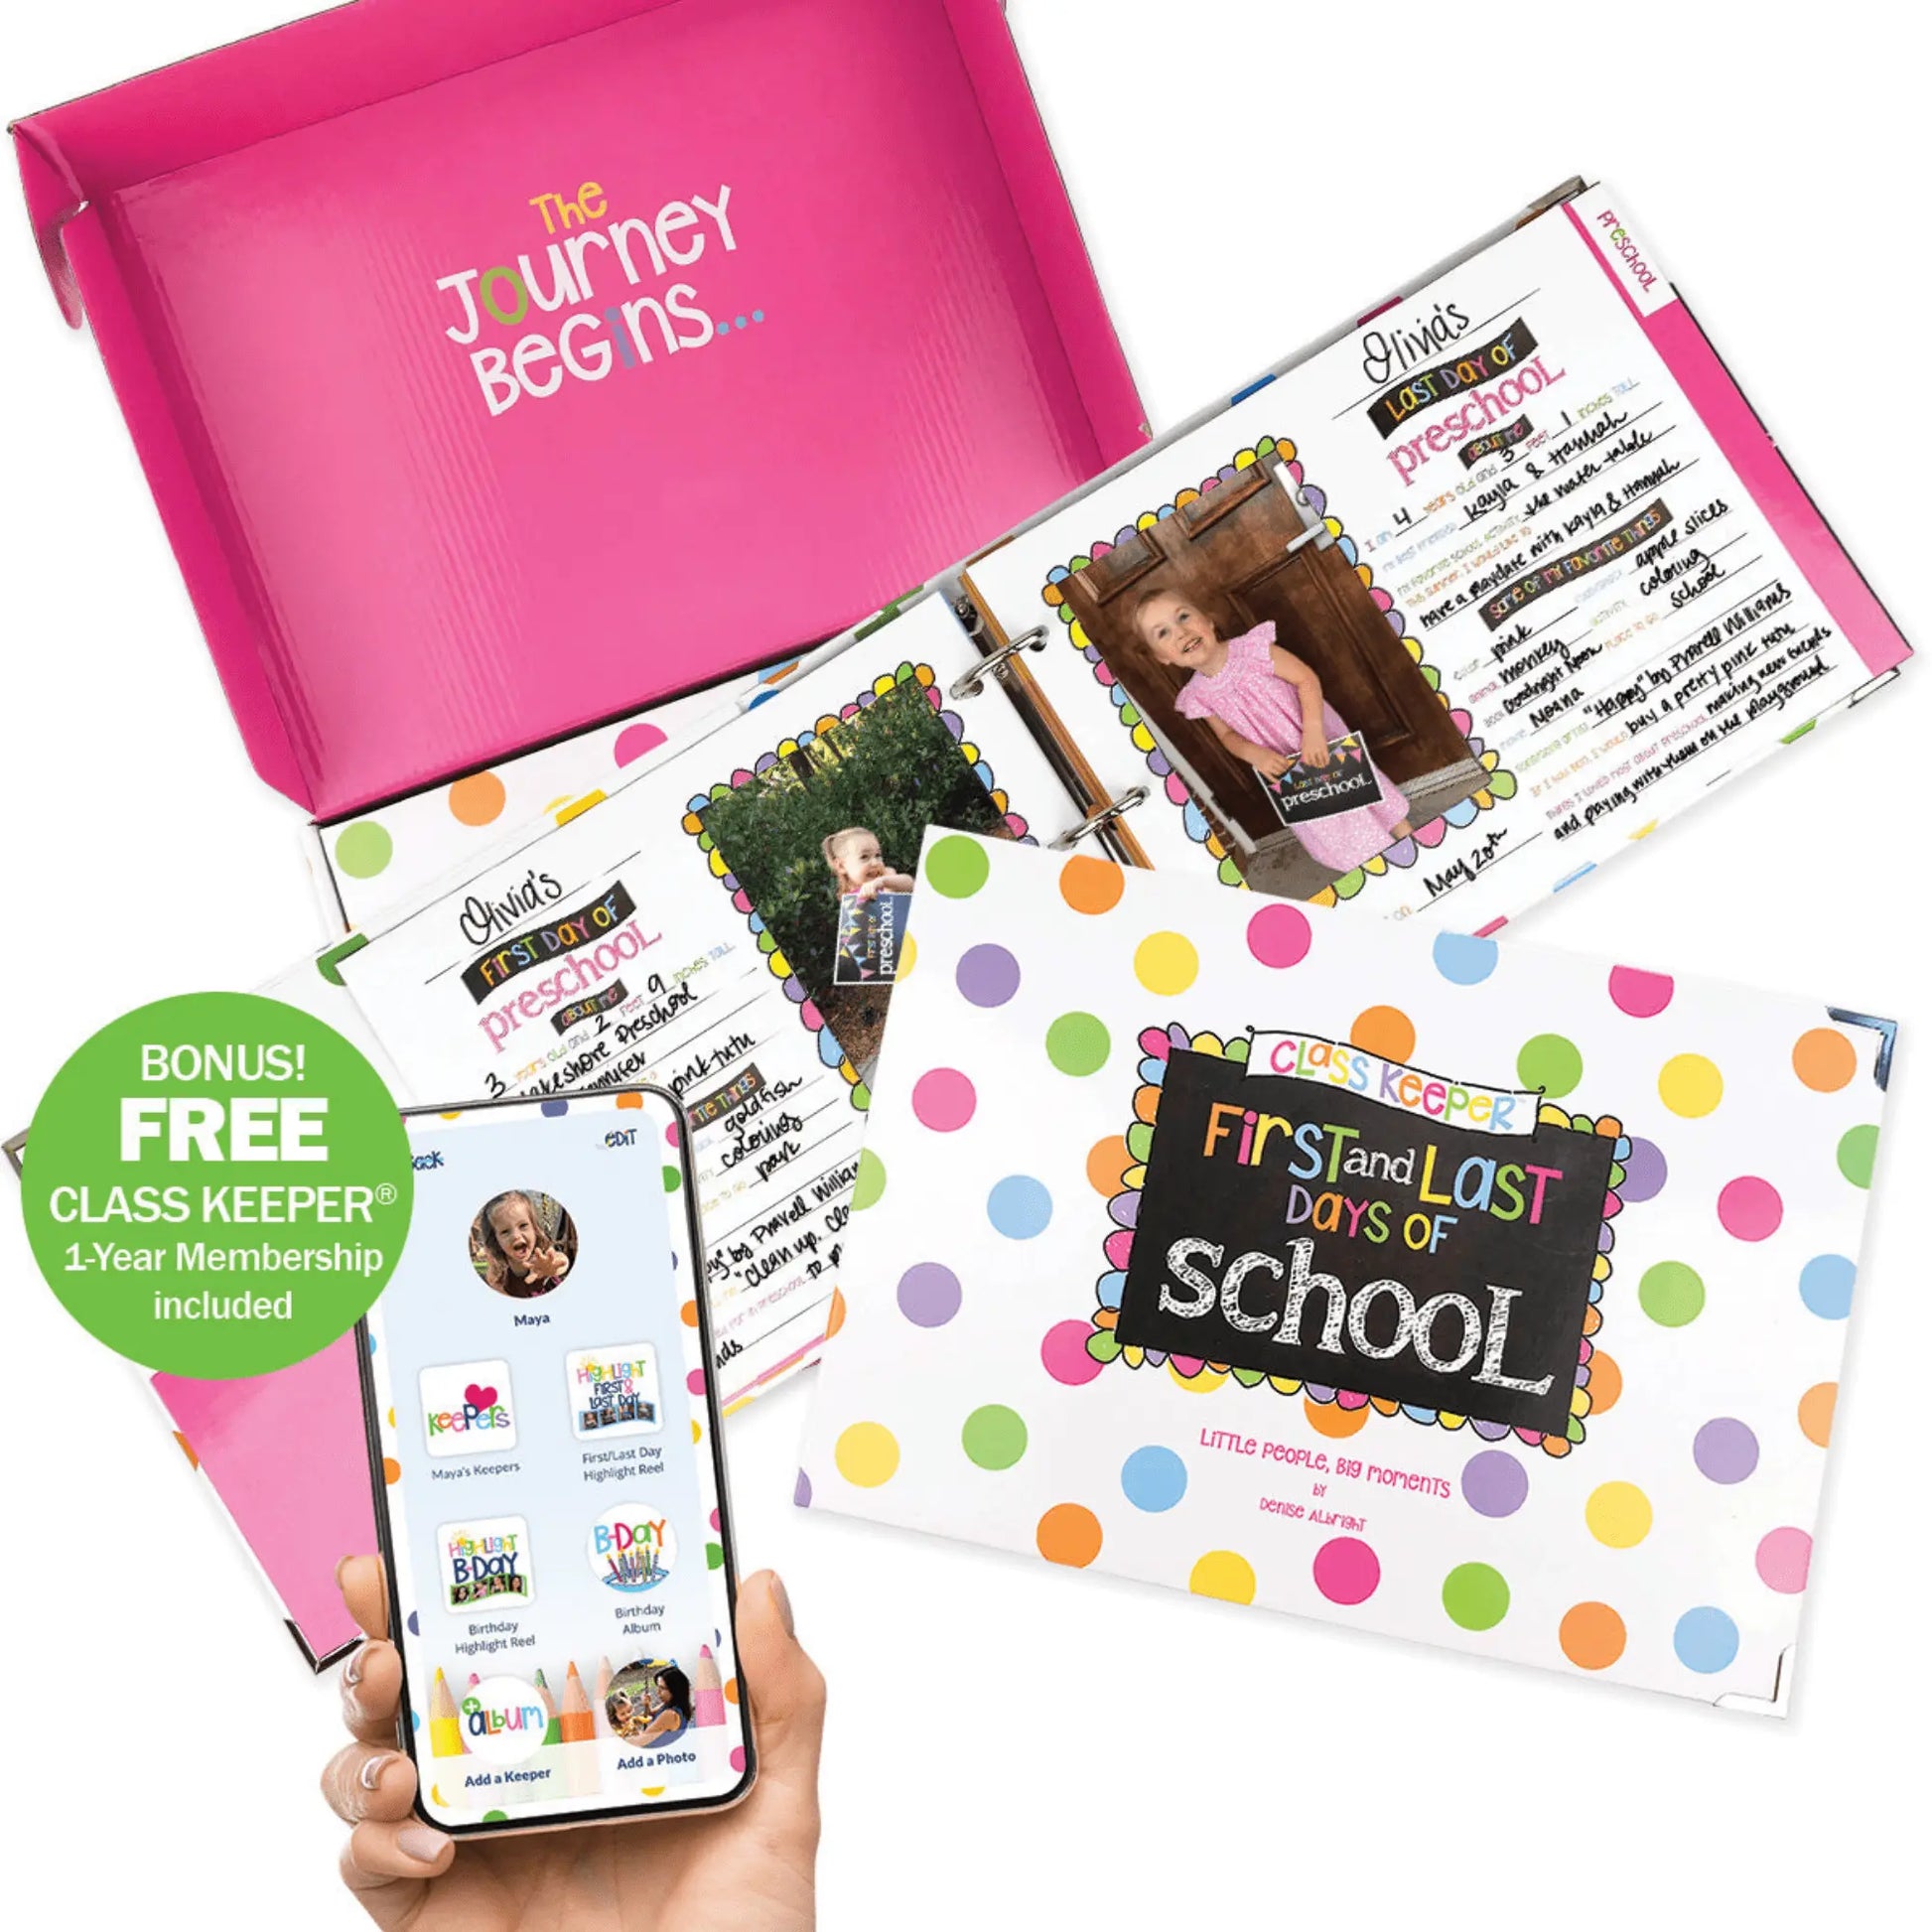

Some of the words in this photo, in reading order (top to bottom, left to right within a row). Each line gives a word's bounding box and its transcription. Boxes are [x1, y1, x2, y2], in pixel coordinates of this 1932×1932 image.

[529, 182, 608, 234] The
[1362, 303, 1470, 384] Olivia's
[1525, 462, 1546, 480] &
[1554, 463, 1602, 497] water
[1603, 429, 1652, 464] table
[1392, 506, 1413, 526] 4
[1498, 447, 1515, 464] 3
[1454, 593, 1468, 606] a
[1605, 491, 1622, 513] &
[1490, 623, 1532, 664] pink
[1635, 527, 1678, 568] apple
[1685, 498, 1729, 536] slices
[1498, 638, 1571, 686] monkey
[1640, 547, 1711, 597] coloring
[1625, 708, 1659, 736] buy
[1661, 698, 1673, 712] a
[1674, 664, 1721, 709] pretty
[1721, 641, 1758, 680] pink
[1757, 655, 1787, 679] new
[1529, 687, 1585, 729] Moana
[1554, 813, 1583, 841] and
[1745, 653, 1830, 722] playground
[1423, 858, 1477, 897] May
[1470, 827, 1509, 870] 20th
[460, 870, 563, 945] Olivia's
[484, 1071, 506, 1099] 3
[595, 1015, 612, 1034] 2
[647, 973, 667, 994] 9
[668, 1054, 711, 1100] pink
[710, 1033, 756, 1068] tutu
[724, 1076, 803, 1141] goldfish
[721, 1111, 803, 1169] coloring
[755, 1141, 801, 1181] park
[1342, 1146, 1415, 1187] and
[1403, 1211, 1458, 1255] OF
[513, 1313, 551, 1327] Maya
[431, 1465, 471, 1481] Maya's
[473, 1461, 521, 1479] Keepers
[582, 1449, 635, 1464] First/Last
[639, 1447, 662, 1460] Day
[583, 1465, 636, 1482] Highlight
[638, 1461, 664, 1475] Reel
[468, 1620, 519, 1636] Birthday
[614, 1603, 665, 1619] Birthday
[622, 1621, 661, 1635] Album
[454, 1638, 508, 1656] Highlight
[510, 1634, 536, 1648] Reel
[464, 1773, 492, 1788] Add
[493, 1774, 502, 1784] a
[503, 1767, 551, 1784] Keeper
[617, 1755, 644, 1771] Add
[645, 1757, 655, 1767] a
[656, 1751, 697, 1765] Photo
